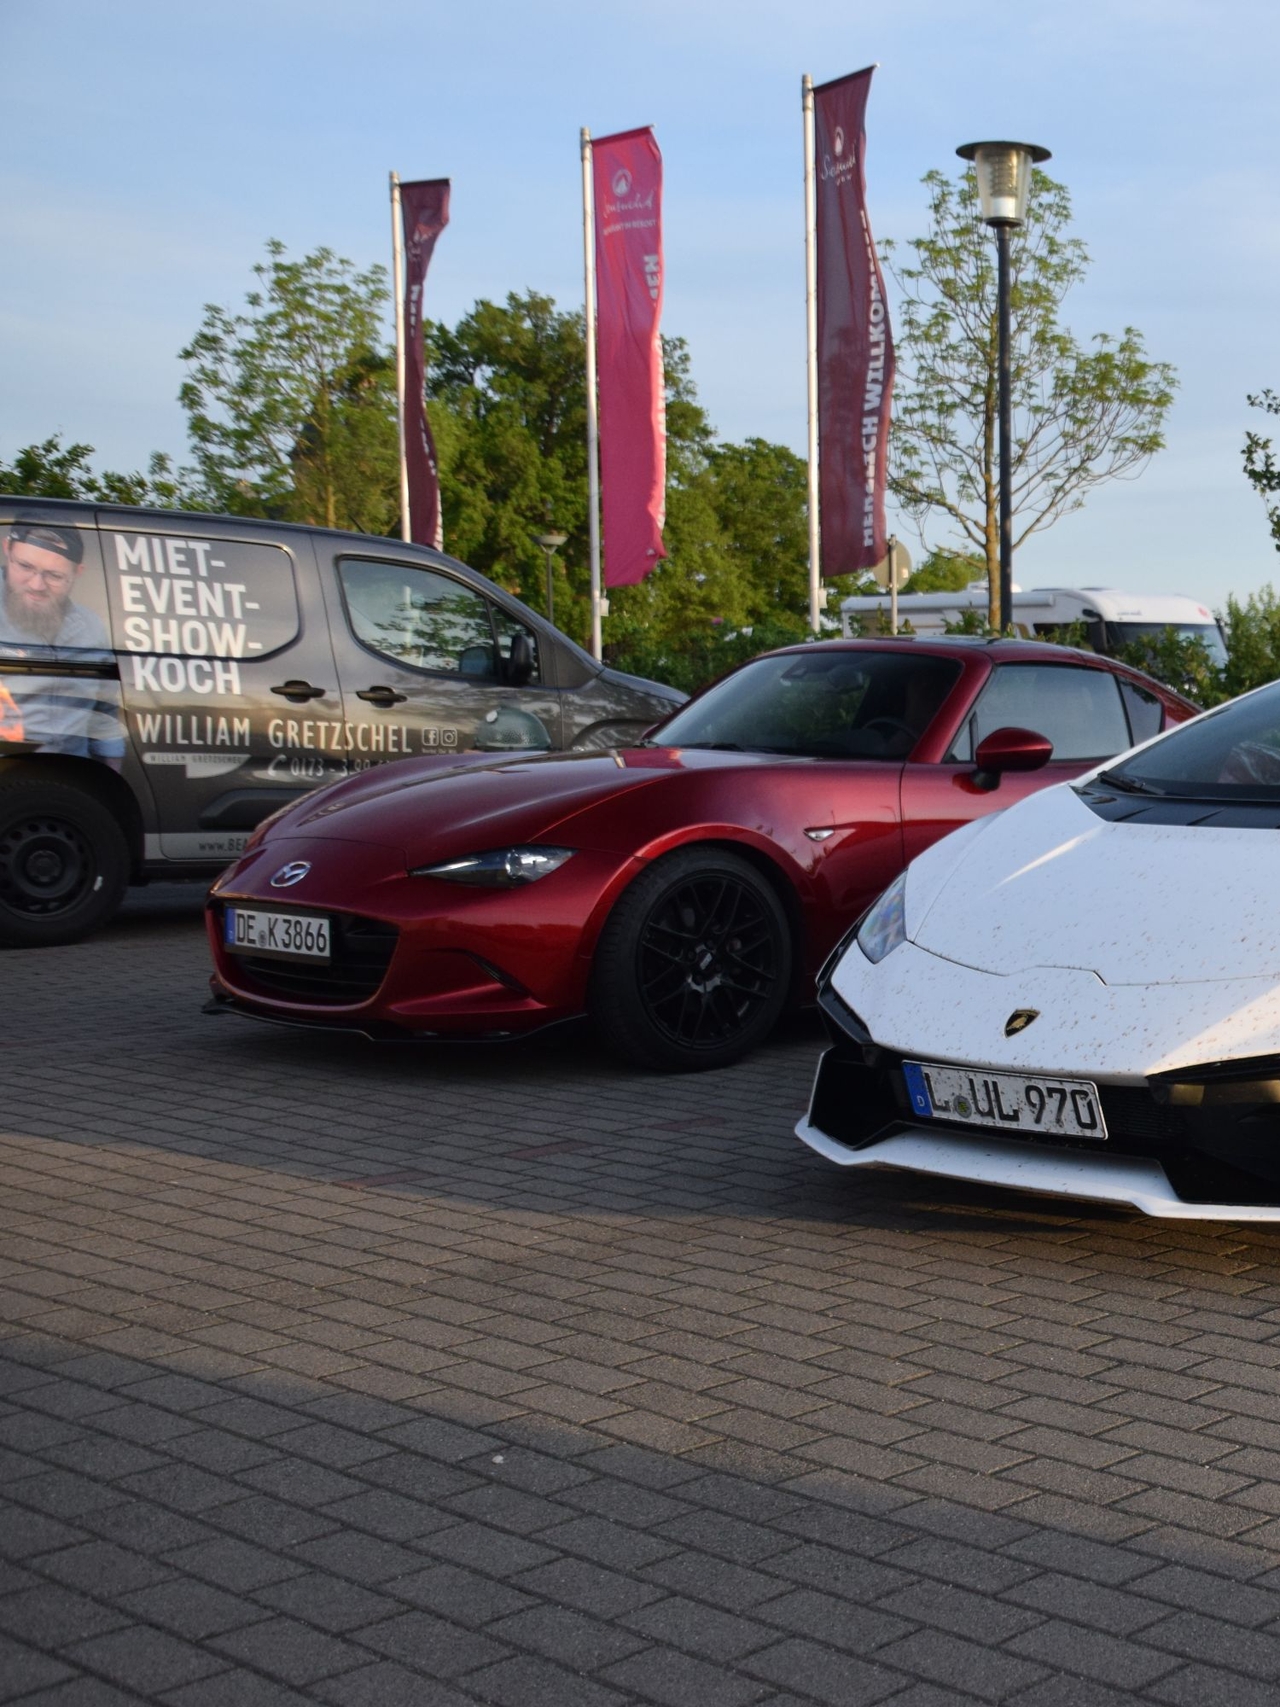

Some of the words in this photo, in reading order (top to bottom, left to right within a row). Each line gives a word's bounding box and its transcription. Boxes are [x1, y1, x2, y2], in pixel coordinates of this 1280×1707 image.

[114, 534, 226, 577] MIET-
[120, 574, 260, 619] EVENT-
[124, 616, 263, 658] SHOW-
[132, 655, 241, 695] KOCH
[136, 713, 250, 747] WILLIAM
[268, 719, 412, 753] GRETZSCHEL
[236, 913, 256, 945] DE
[923, 1072, 951, 1113] L
[969, 1078, 1019, 1122] UL
[1024, 1084, 1098, 1130] 970
